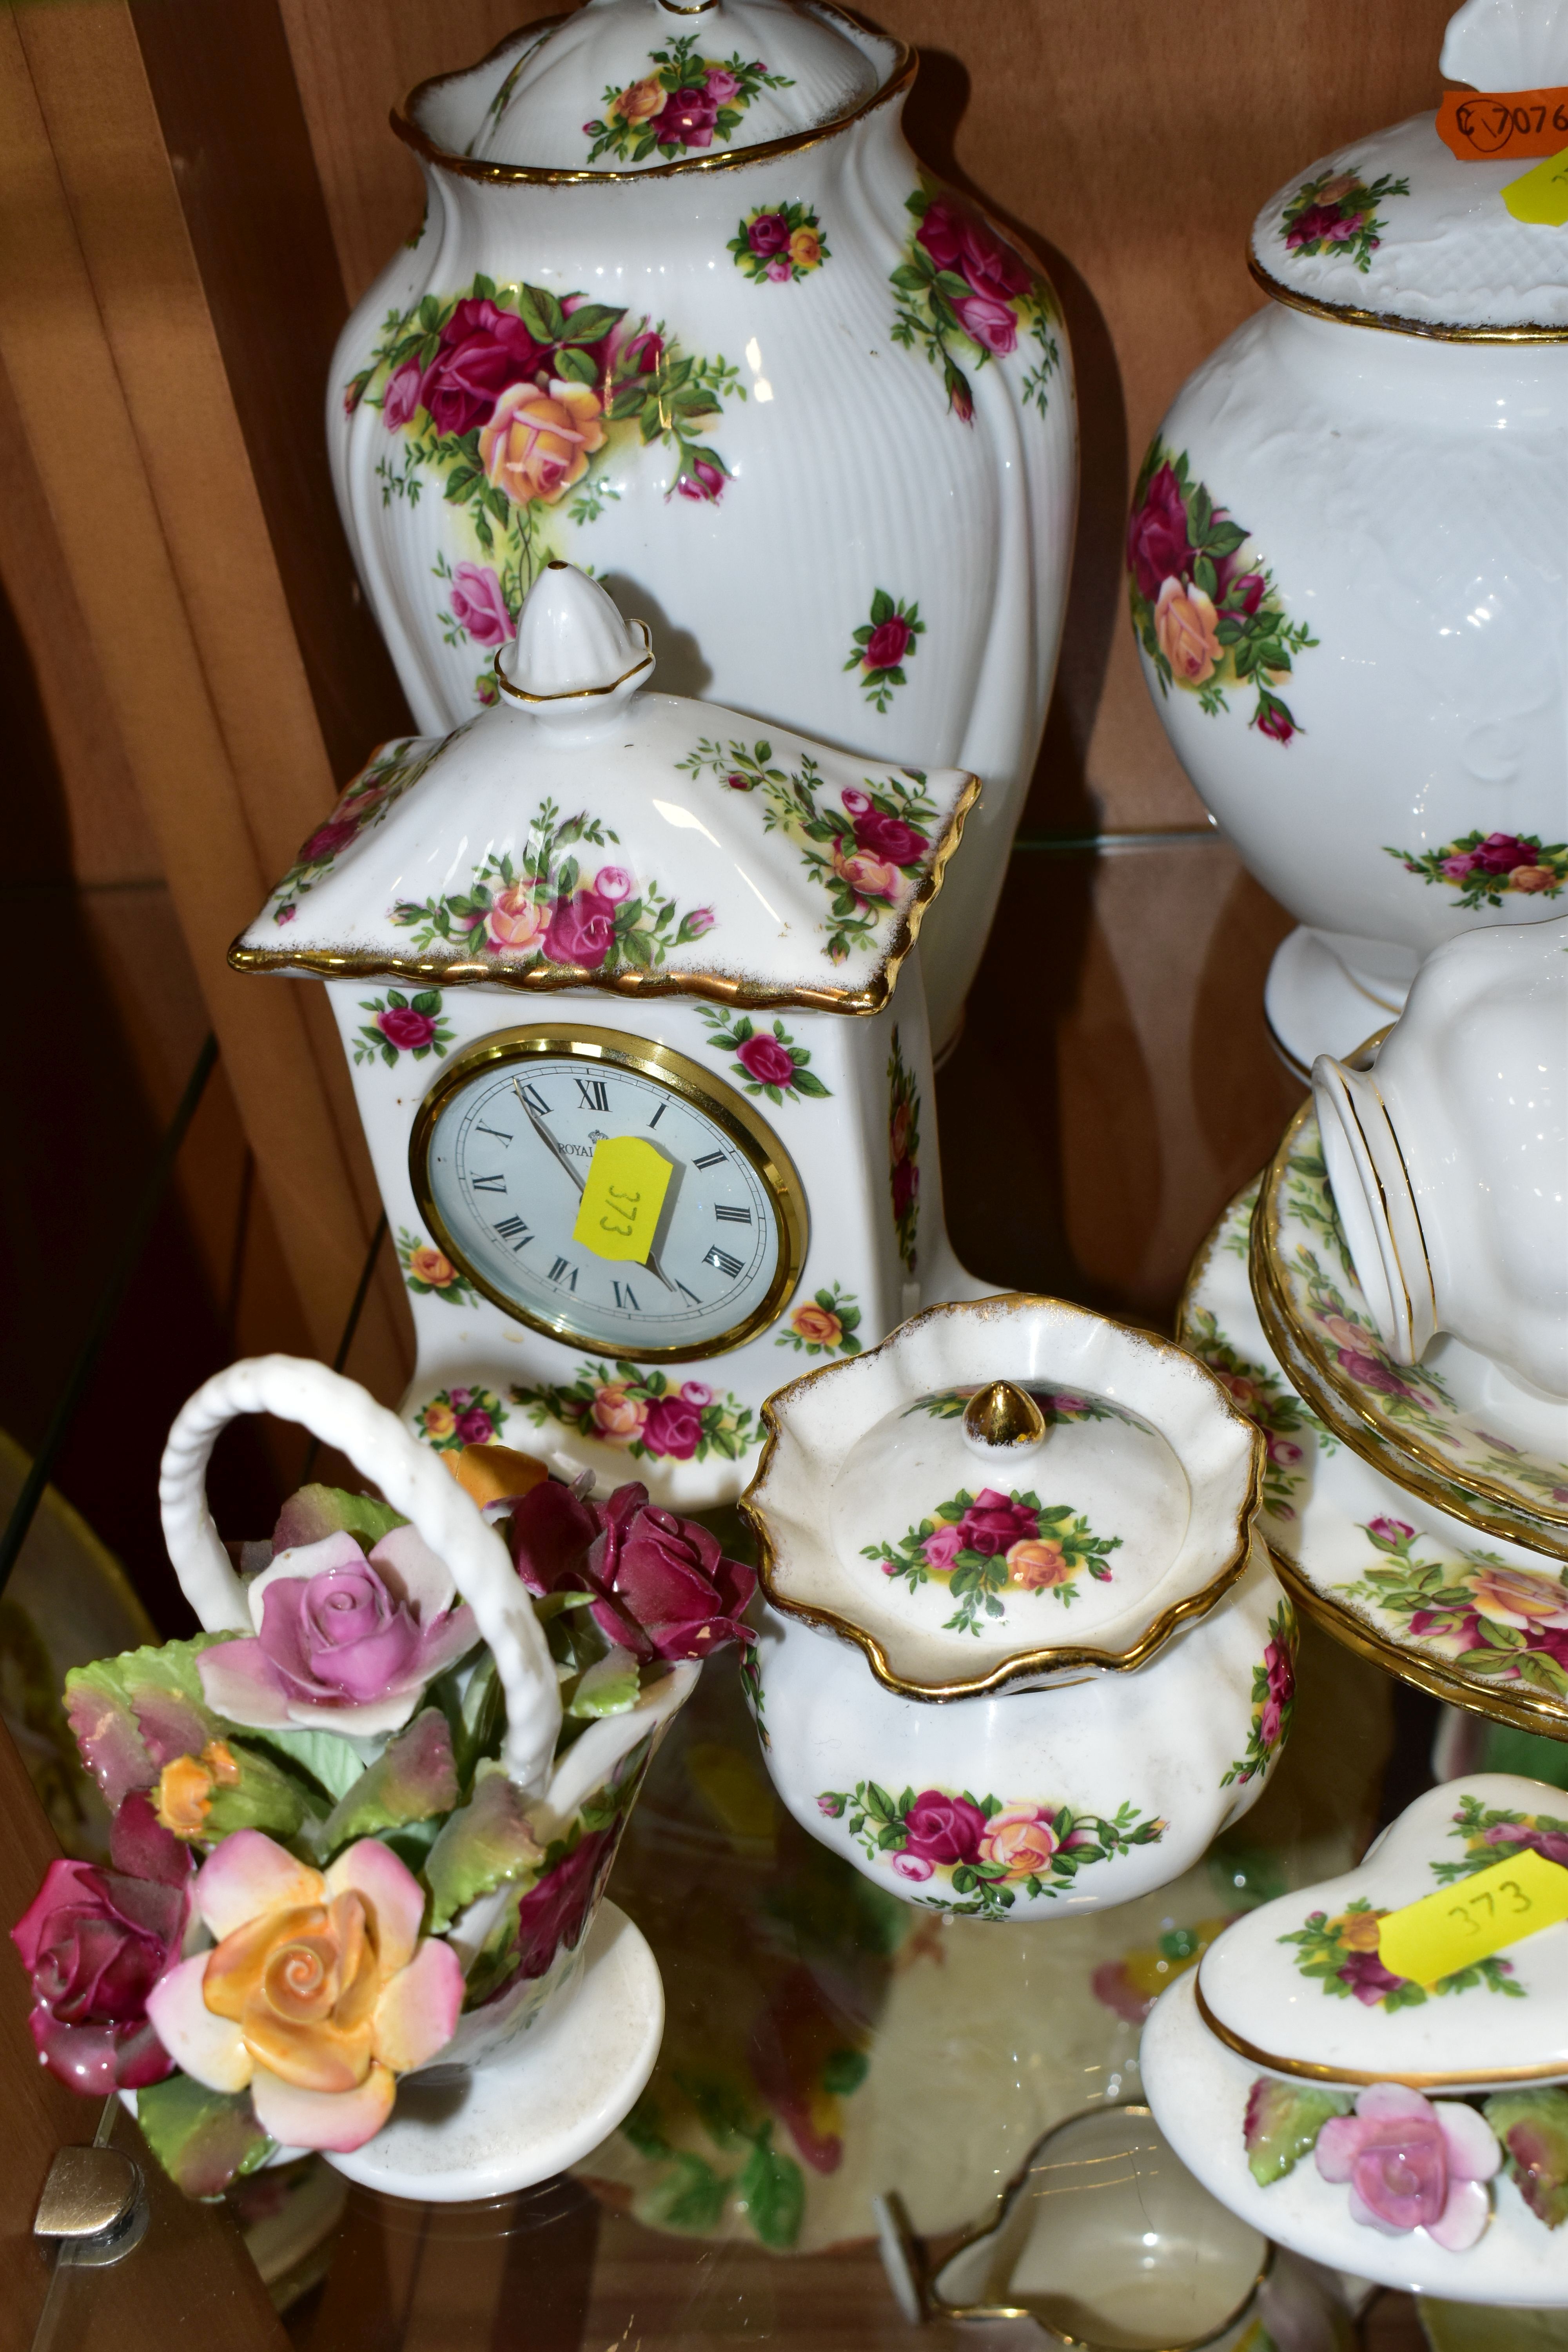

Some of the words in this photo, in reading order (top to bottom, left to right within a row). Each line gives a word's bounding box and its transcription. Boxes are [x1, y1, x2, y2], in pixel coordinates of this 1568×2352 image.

[512, 1083, 554, 1119] XI
[573, 1078, 613, 1112] XII
[646, 1101, 668, 1130] I
[475, 1118, 514, 1149] X
[692, 1149, 730, 1172] II
[472, 1171, 508, 1195] IX
[599, 1184, 641, 1237] 373
[714, 1202, 752, 1225] III
[493, 1214, 536, 1252] VIII
[548, 1256, 581, 1293] VII
[610, 1279, 642, 1311] VI
[673, 1278, 704, 1308] V
[1448, 1880, 1532, 1936] 373
